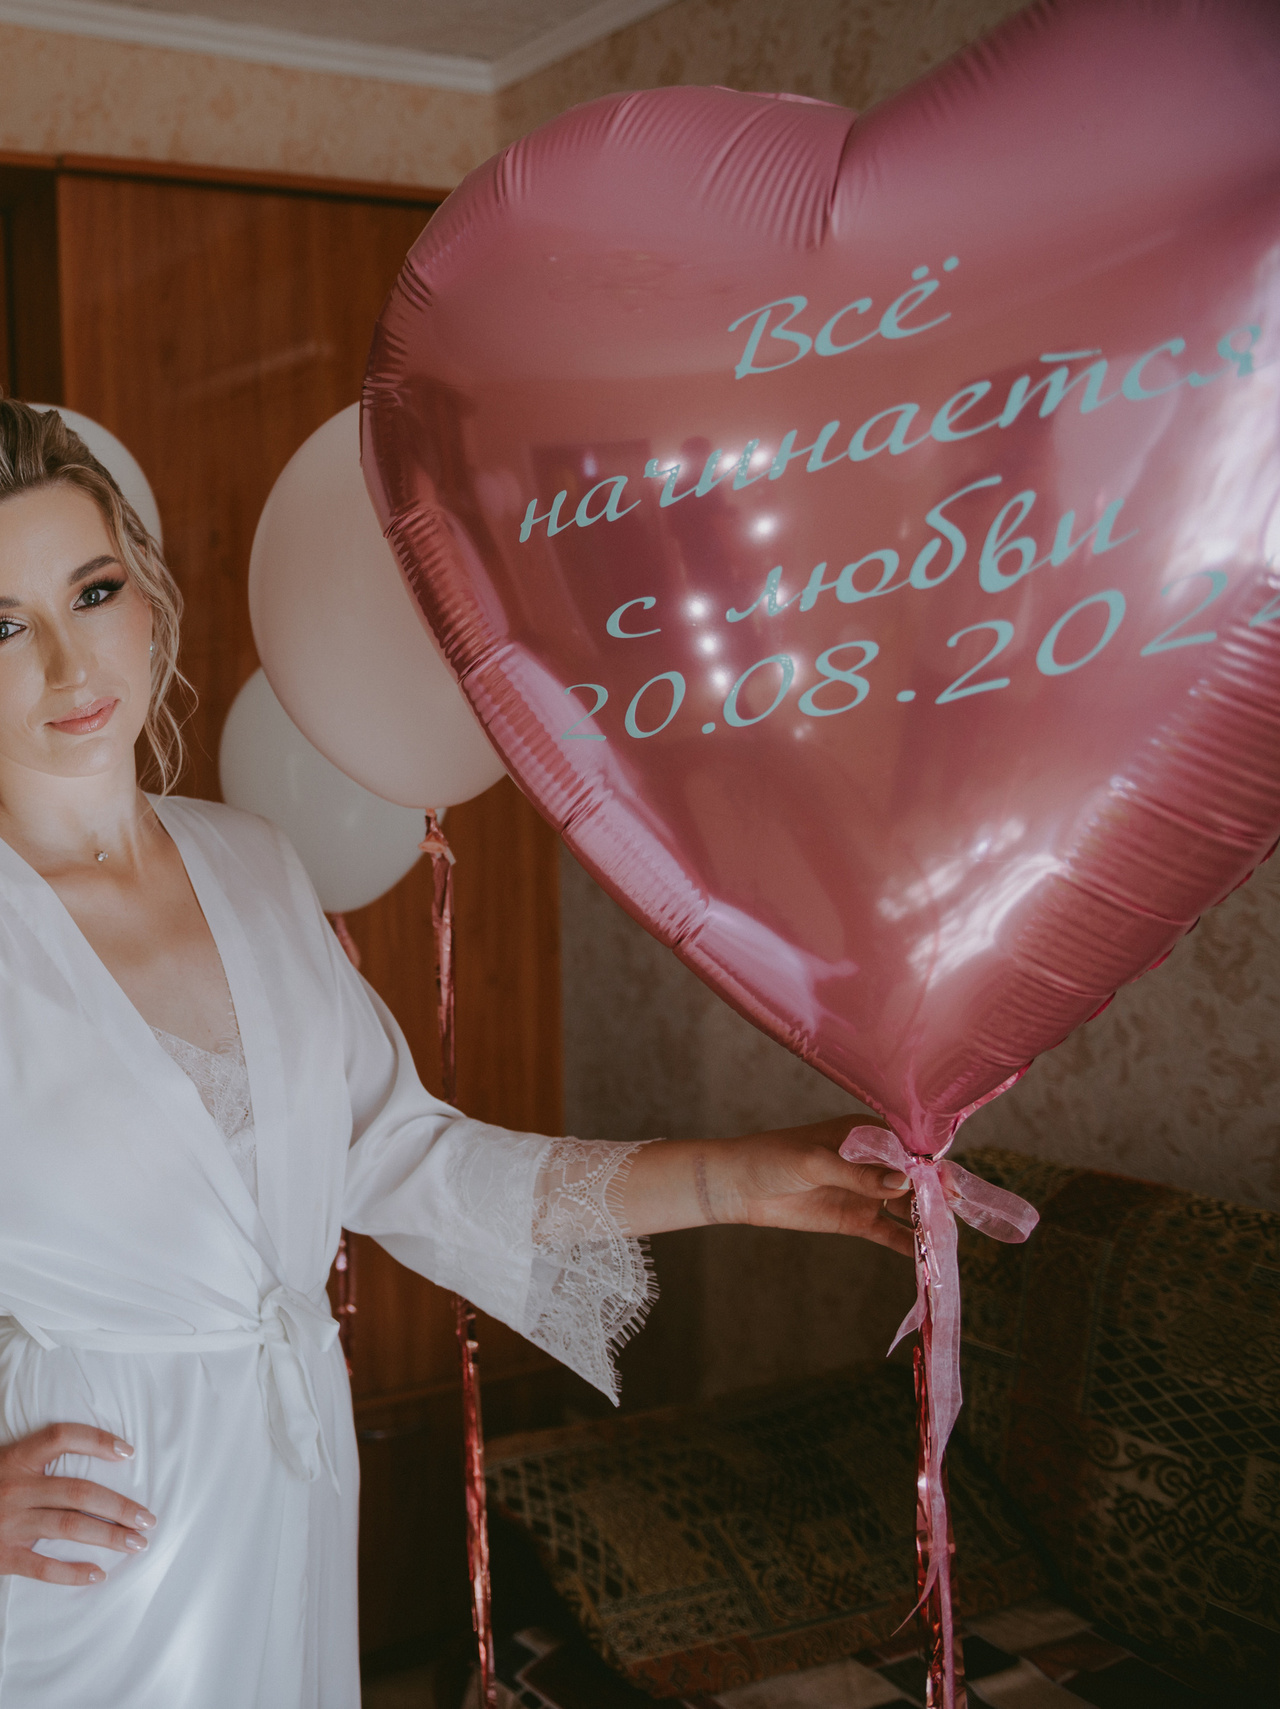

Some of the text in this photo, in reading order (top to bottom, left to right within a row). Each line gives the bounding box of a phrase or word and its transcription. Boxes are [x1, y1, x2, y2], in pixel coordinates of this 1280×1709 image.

[727, 256, 959, 379] Всё
[519, 324, 1265, 543] начинается
[606, 475, 1140, 639] с любви
